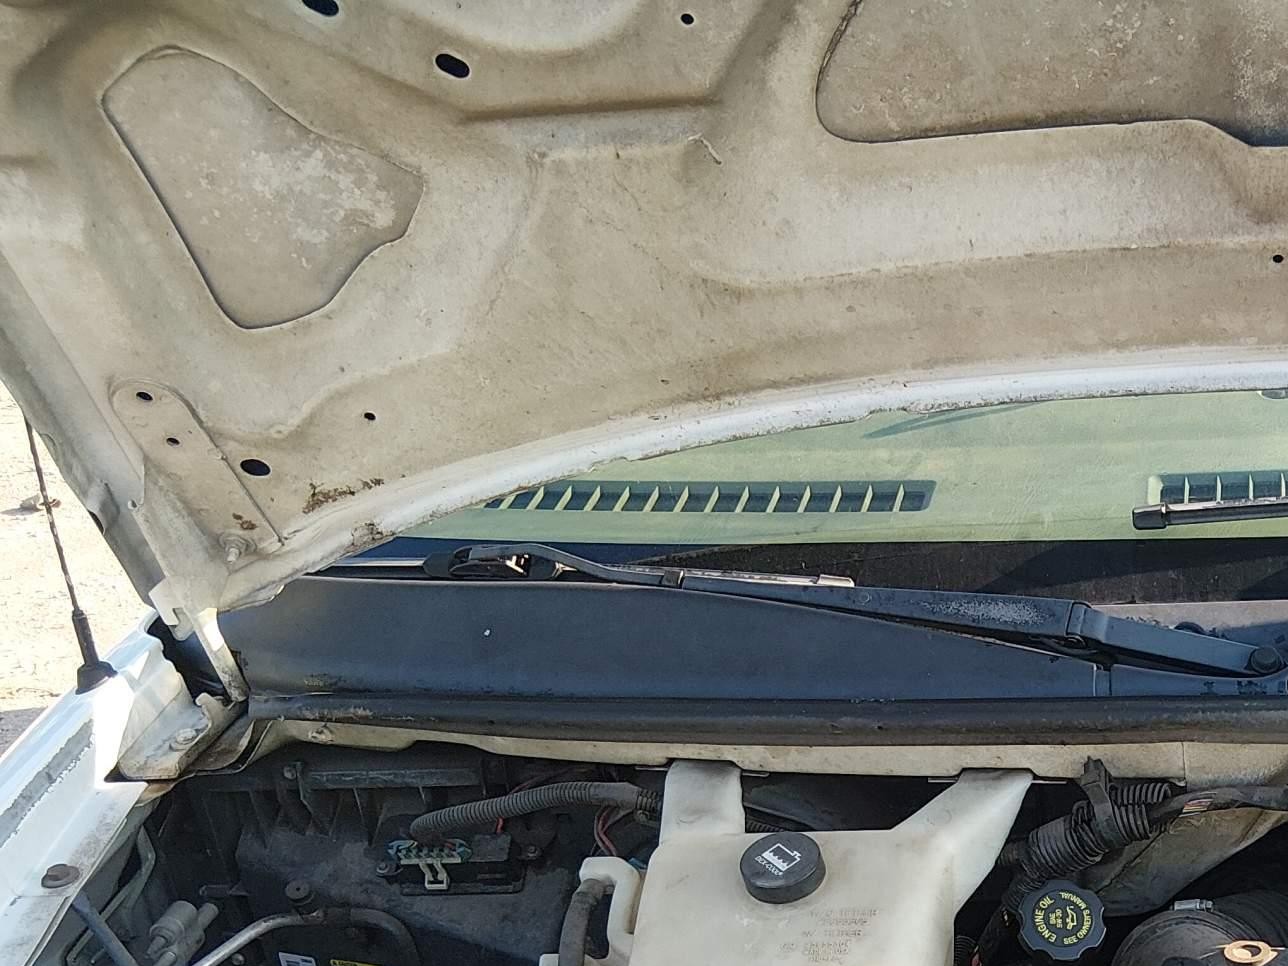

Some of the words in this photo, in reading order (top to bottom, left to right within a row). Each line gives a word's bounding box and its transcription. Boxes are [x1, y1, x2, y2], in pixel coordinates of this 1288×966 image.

[1039, 895, 1055, 909] OIL
[1059, 891, 1087, 910] MANUAL
[1034, 908, 1057, 943] ENGINE
[1055, 908, 1063, 929] 5W-30
[1076, 909, 1092, 939] OWNER'S
[1063, 935, 1079, 945] SEE
